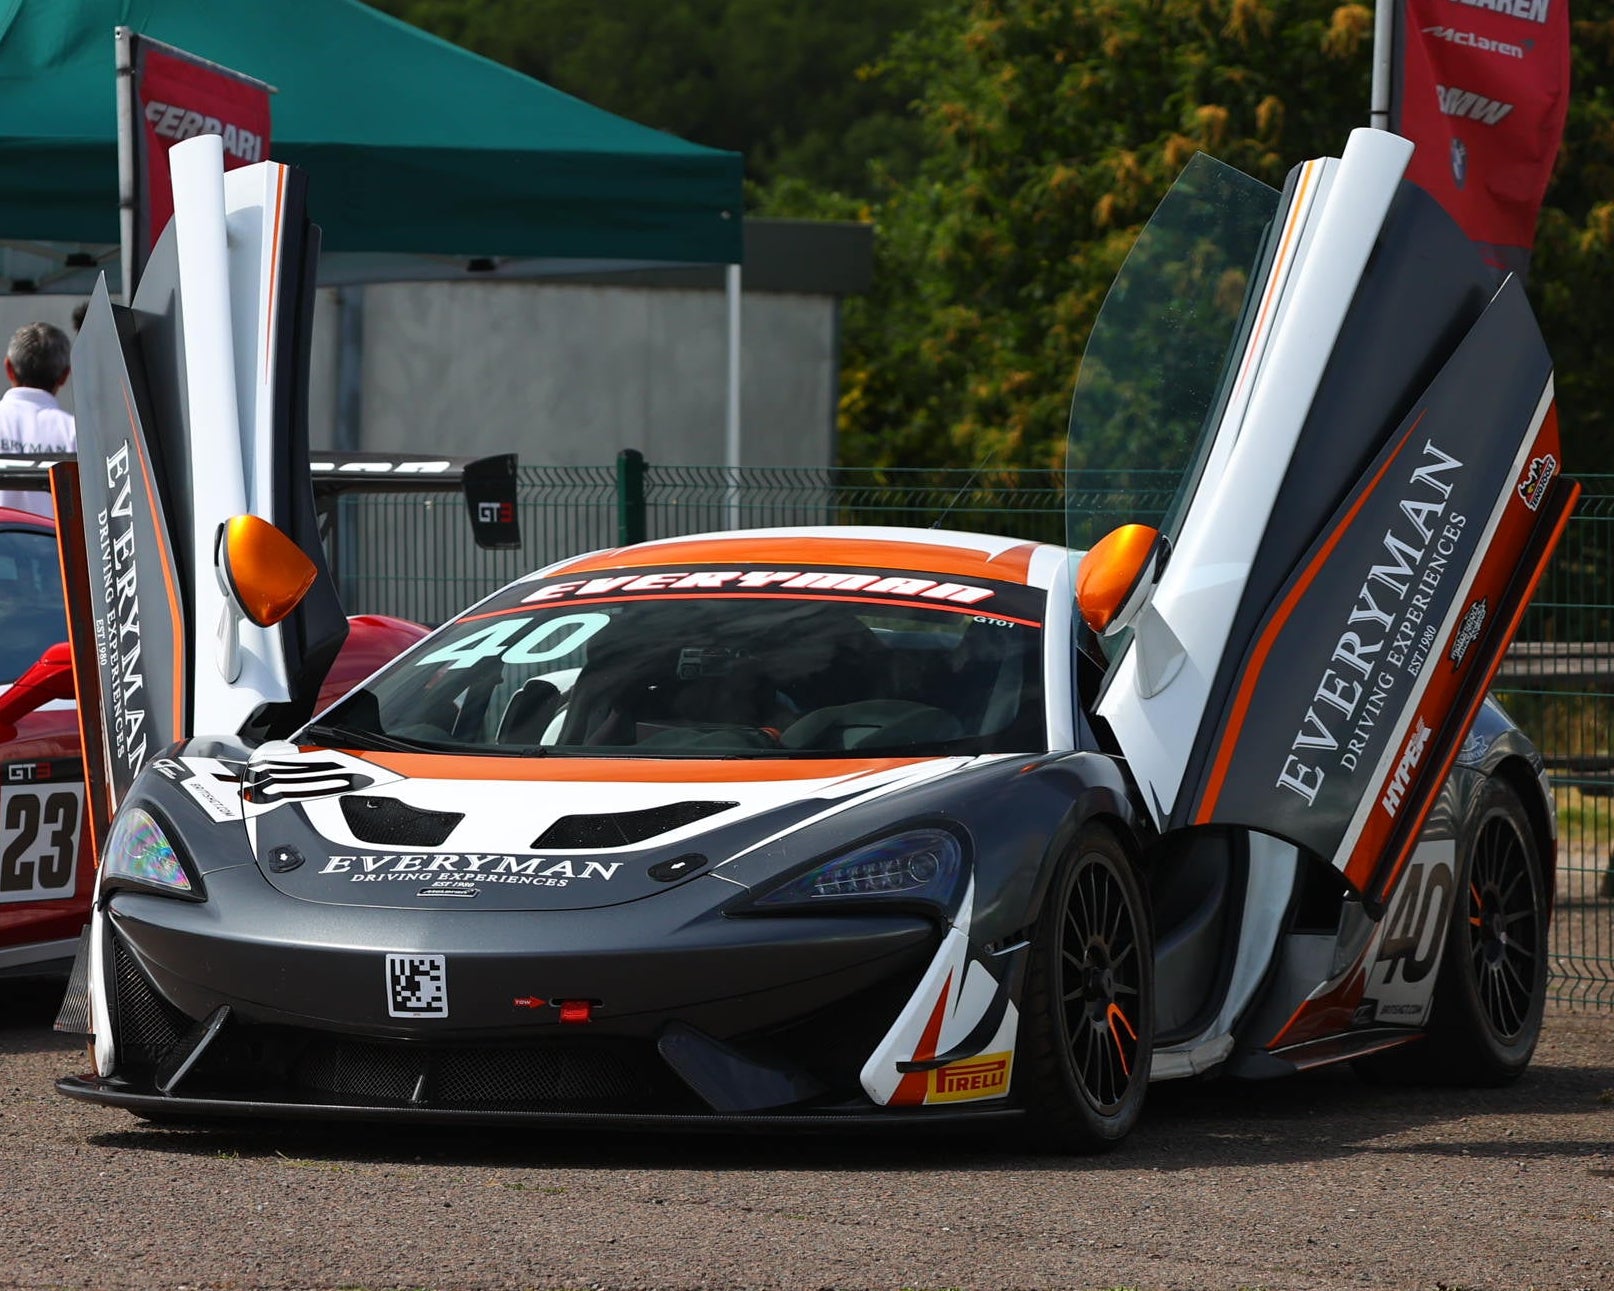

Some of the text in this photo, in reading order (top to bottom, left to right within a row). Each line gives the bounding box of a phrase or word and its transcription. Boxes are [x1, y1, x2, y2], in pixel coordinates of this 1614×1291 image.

[1451, 0, 1549, 23] AREN
[1421, 26, 1523, 59] McLaren
[145, 100, 262, 162] FERRARI
[478, 502, 512, 522] GT3
[98, 507, 124, 758] DRIVING EXPERIENCES
[106, 439, 147, 779] EVERYMAN
[973, 615, 1015, 629] GT01
[1276, 439, 1463, 807] EVERYMAN
[96, 619, 108, 666] EST 1980
[415, 612, 611, 670] 40
[1341, 511, 1467, 772] DRIVING EXPERIENCES
[1407, 624, 1436, 677] EST 1980
[8, 764, 50, 781] GT3
[0, 791, 79, 891] 23
[318, 854, 624, 881] EVERYMAN
[350, 873, 569, 887] DRIVING EXPERIENCES
[1375, 862, 1454, 984] 40
[935, 1060, 1006, 1093] PIRELLI
